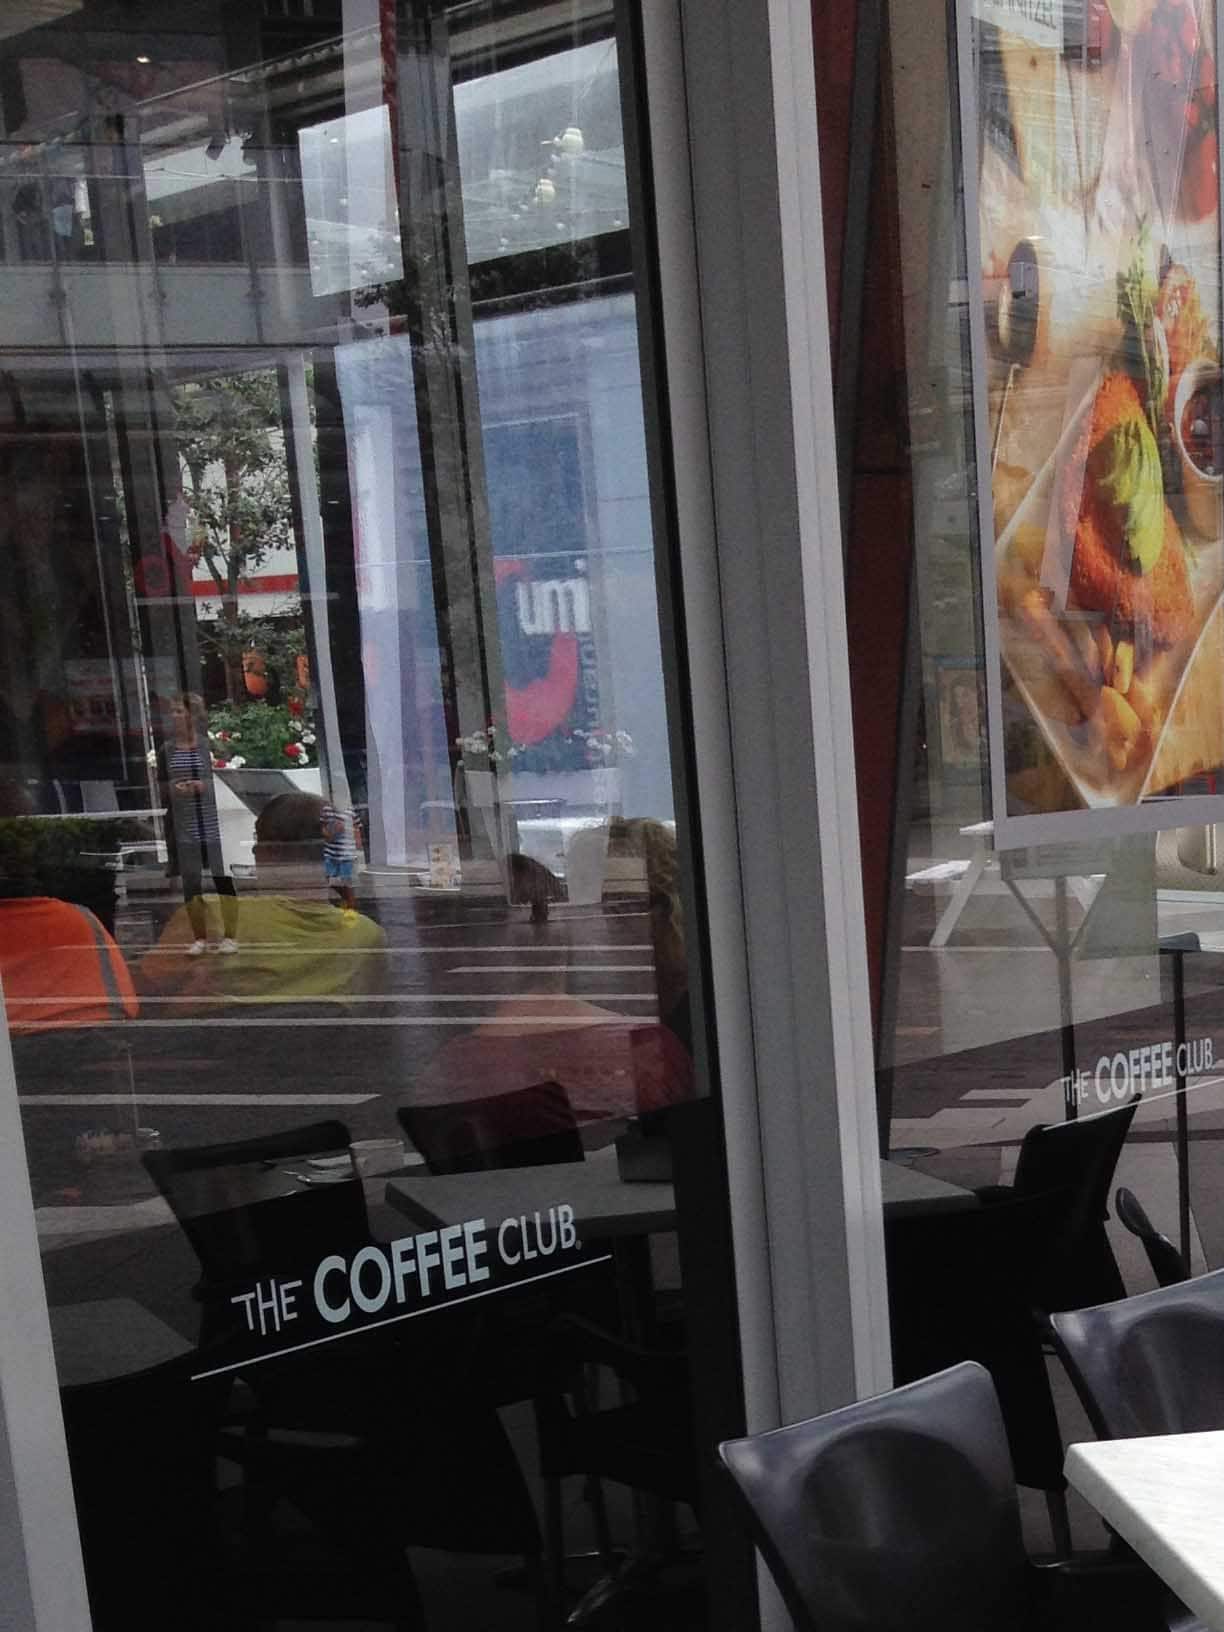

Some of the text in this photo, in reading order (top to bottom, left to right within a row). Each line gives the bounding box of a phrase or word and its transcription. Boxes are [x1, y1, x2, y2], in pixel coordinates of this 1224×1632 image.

[1060, 1037, 1214, 1106] THE COFFEE CLUB
[231, 1204, 577, 1336] THE COFFEE CLUB
